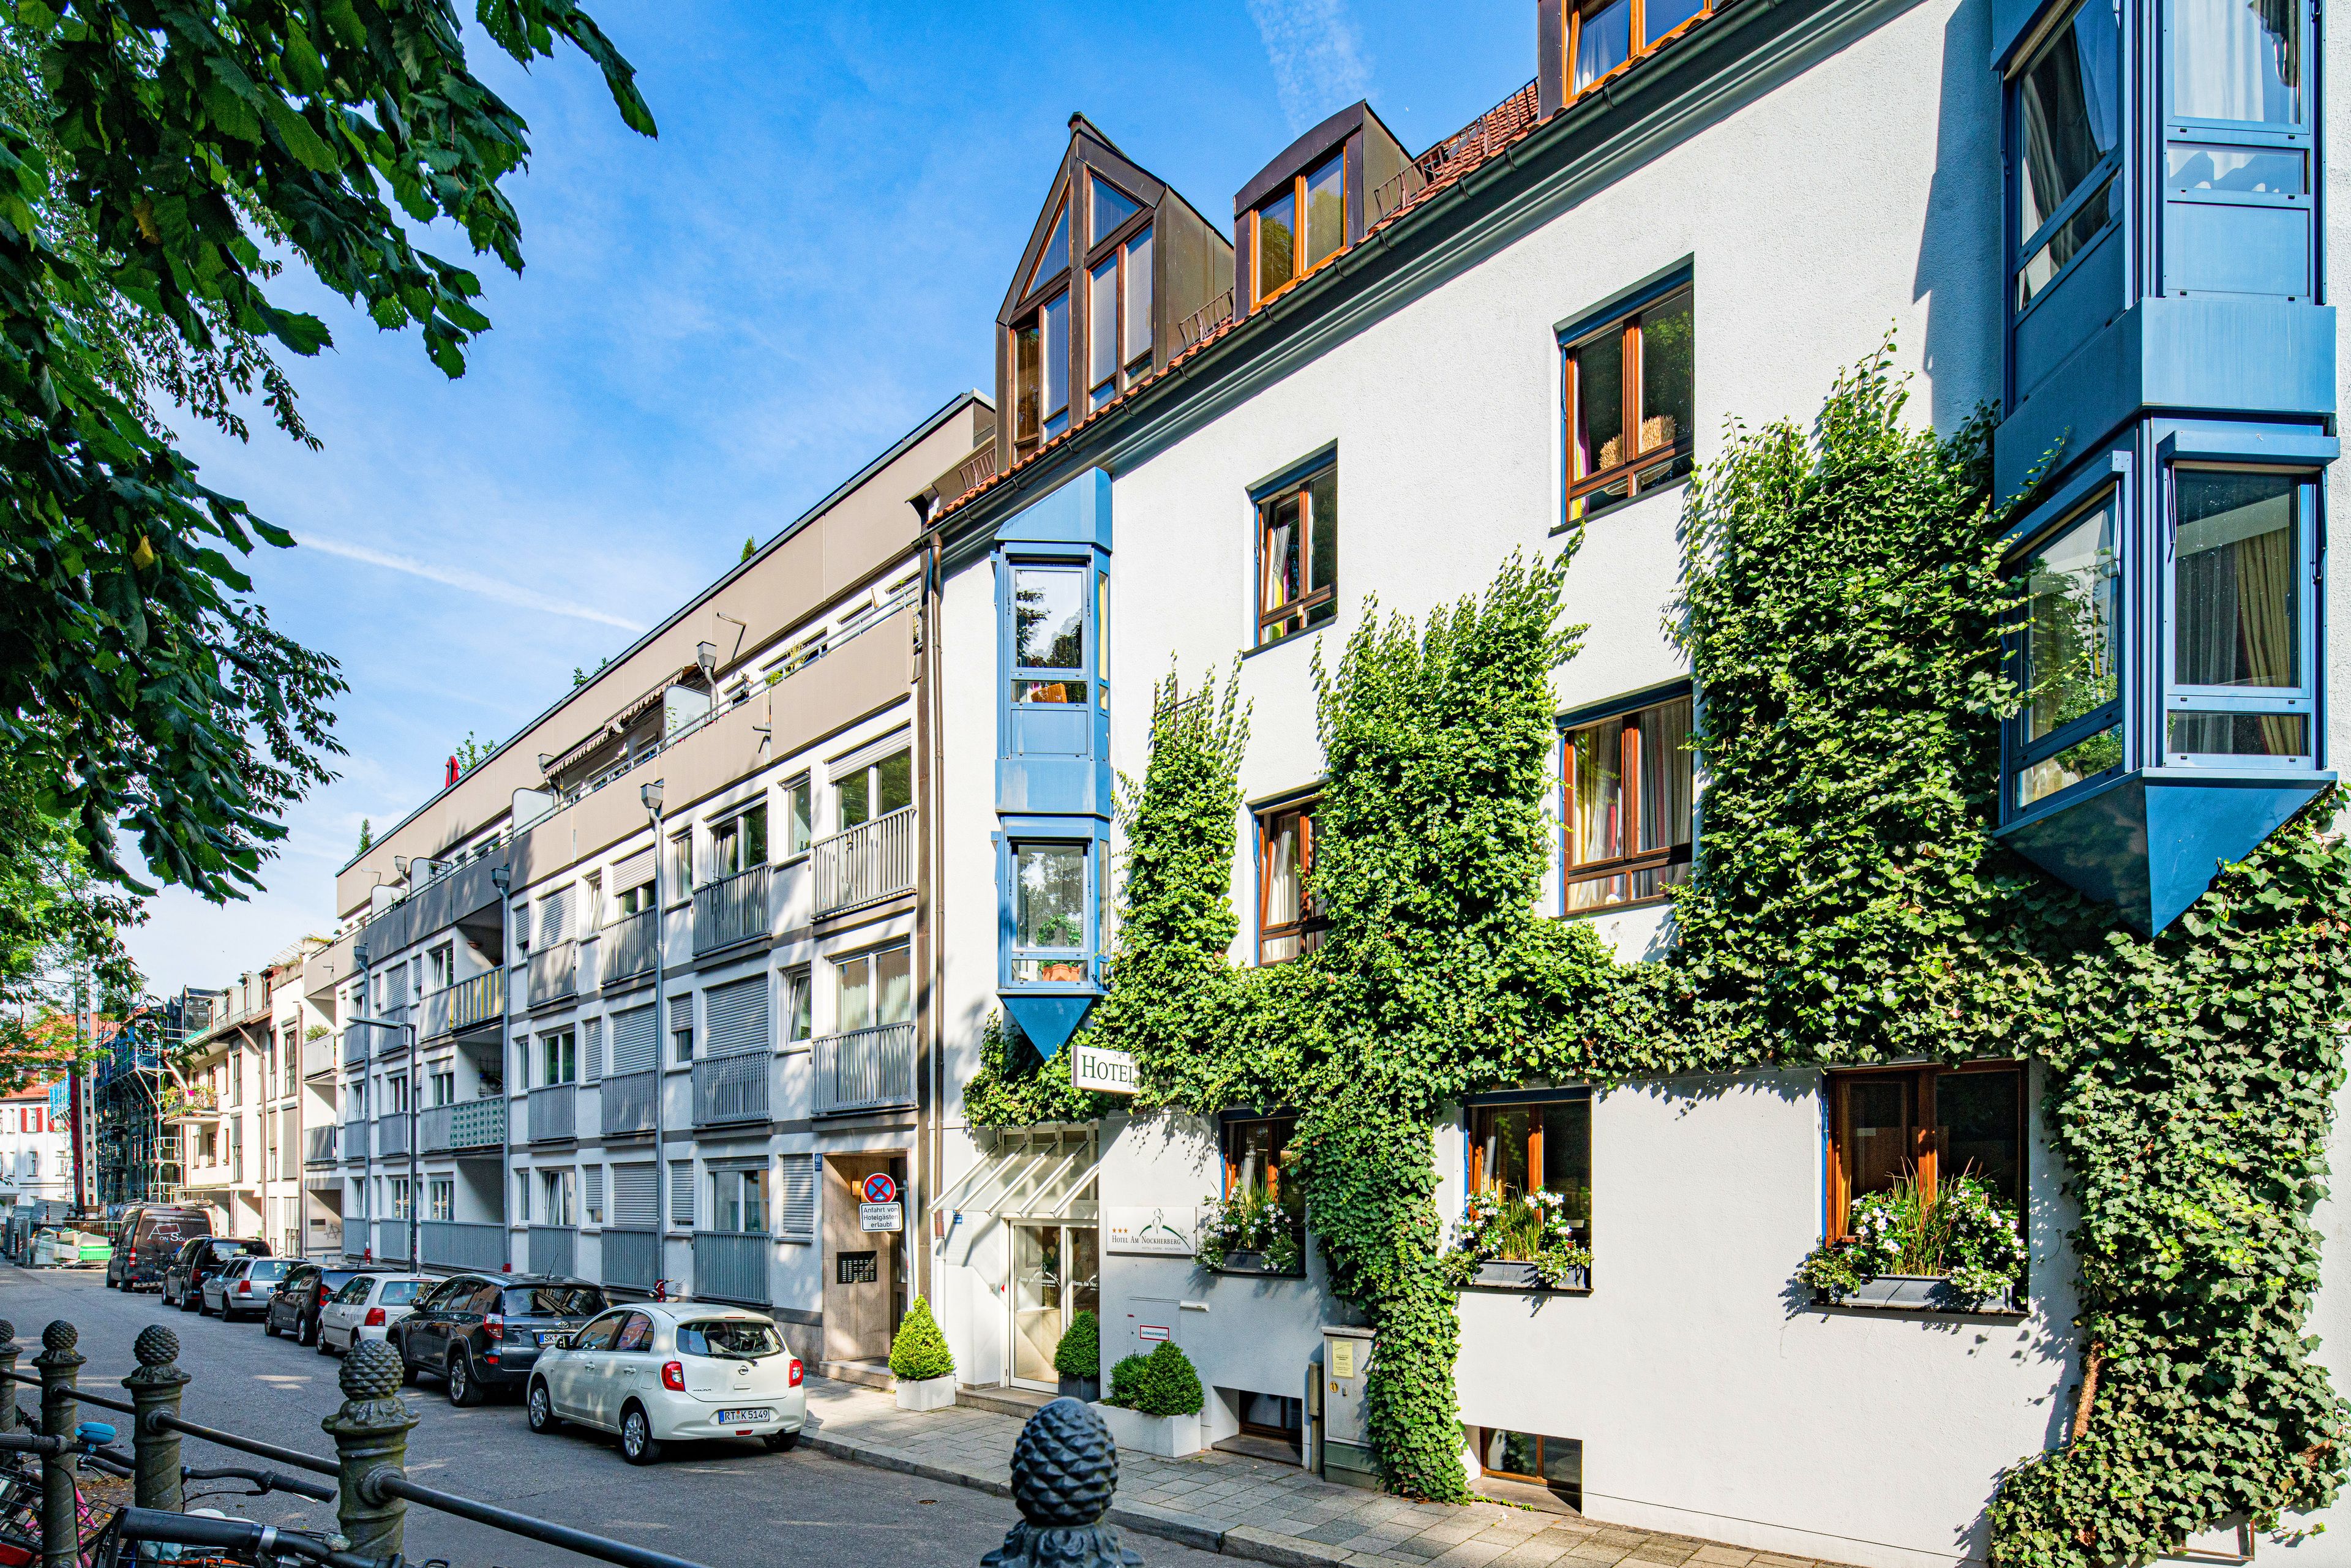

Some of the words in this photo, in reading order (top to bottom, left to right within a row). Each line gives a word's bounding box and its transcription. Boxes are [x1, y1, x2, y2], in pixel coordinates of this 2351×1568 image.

[1081, 1054, 1135, 1084] HOTEL
[815, 1155, 821, 1163] 40
[1112, 1235, 1129, 1244] HOTEL
[1141, 1236, 1182, 1245] NOCKHERBERG
[725, 1411, 736, 1420] RT
[741, 1411, 747, 1419] K
[748, 1410, 768, 1419] 5149
